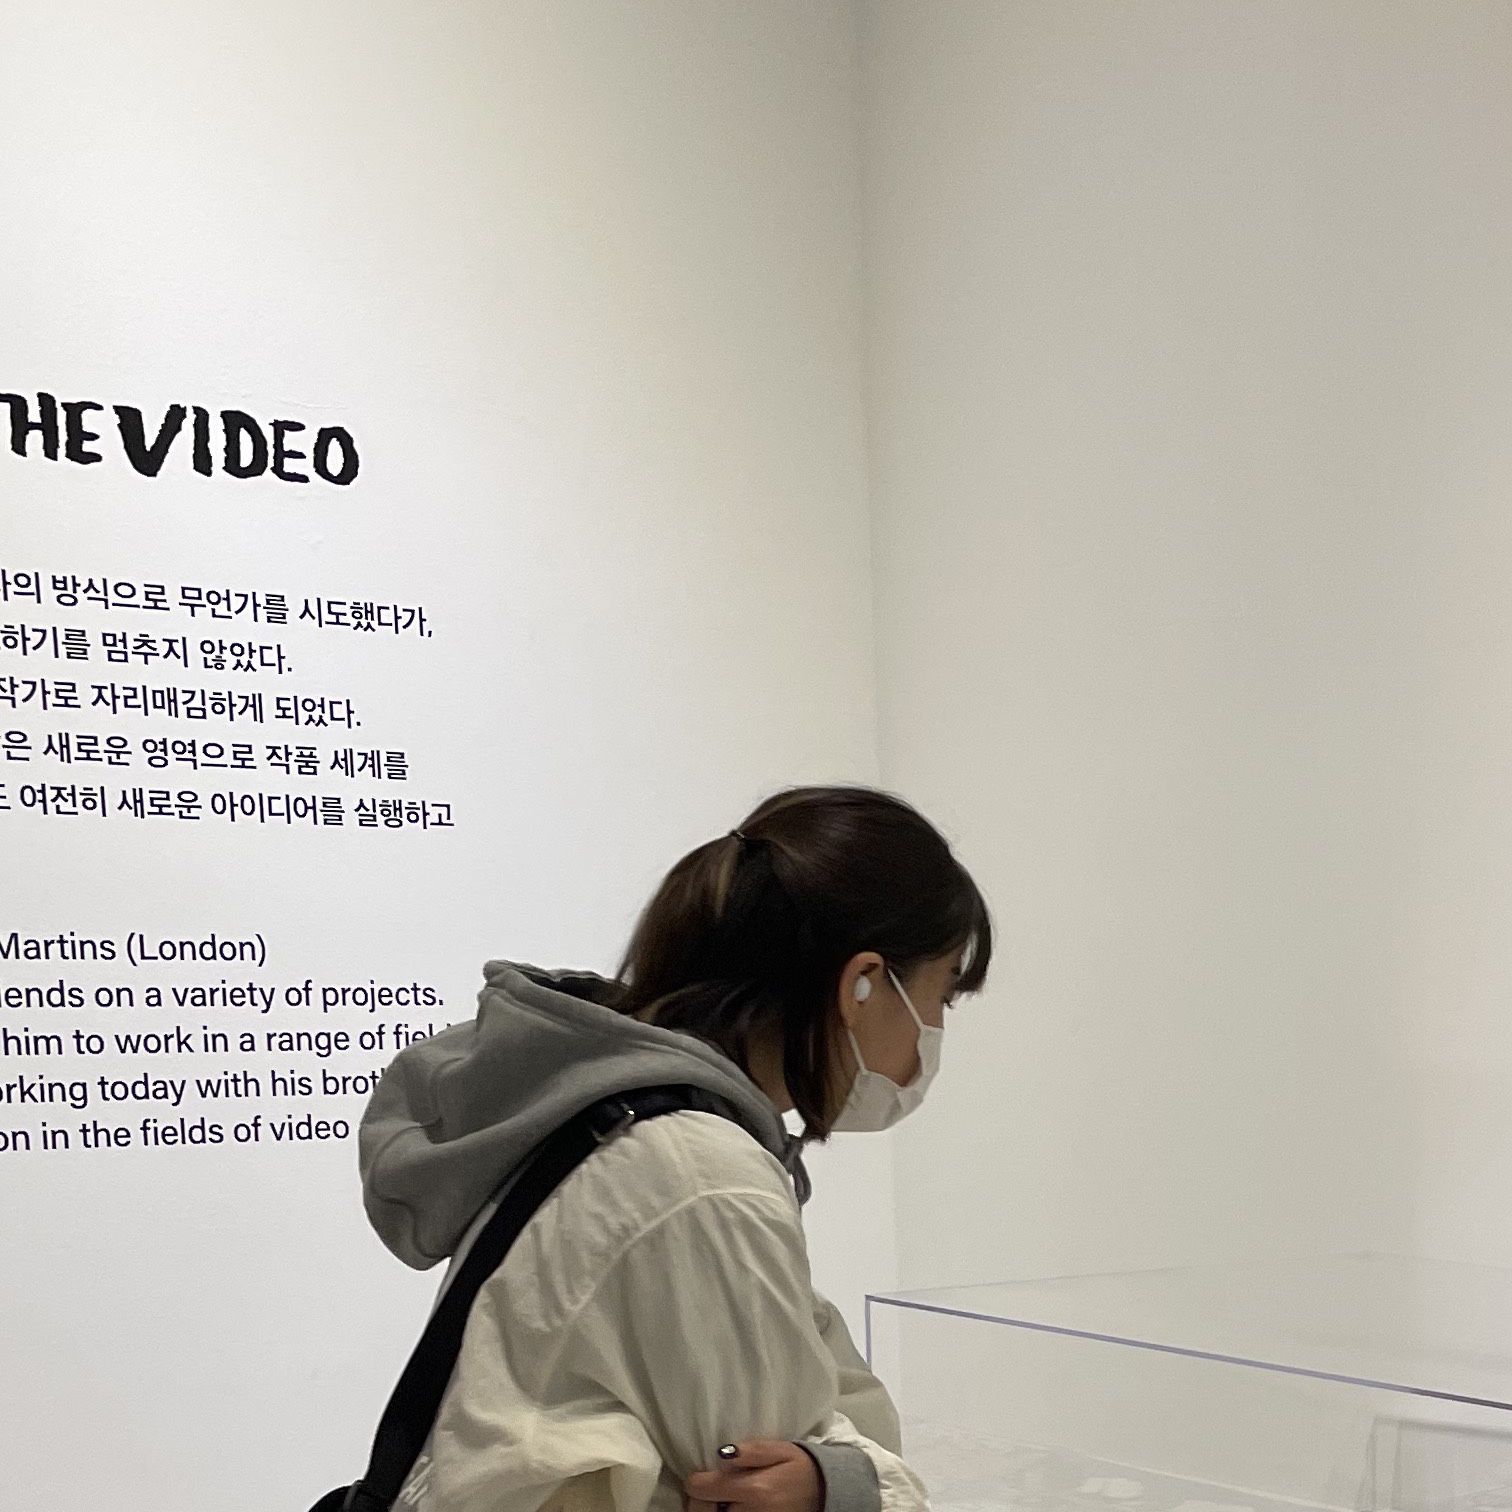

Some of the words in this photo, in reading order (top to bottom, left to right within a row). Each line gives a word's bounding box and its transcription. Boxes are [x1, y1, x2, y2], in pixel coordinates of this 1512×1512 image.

[0, 391, 105, 466] HE
[112, 403, 360, 486] VIDEO
[51, 574, 171, 612] 방식으로
[178, 586, 290, 625] 무언가를
[298, 597, 433, 638] 시도했다가,
[0, 623, 91, 661] 하기를
[101, 631, 189, 668] 멈추지
[199, 639, 293, 675] 않았다.
[0, 676, 82, 711] 작가로
[90, 682, 264, 724] 자리매김하게
[274, 695, 361, 729] 되었다.
[0, 730, 32, 762] 은
[42, 732, 133, 767] 새로운
[142, 737, 257, 771] 영역으로
[265, 744, 321, 776] 작품
[329, 747, 409, 781] 세계를
[19, 783, 107, 818] 여전히
[117, 787, 203, 820] 새로운
[210, 791, 346, 826] 아이디어를
[354, 797, 455, 830] 실행하고
[0, 931, 116, 961] Martins
[126, 932, 266, 968] (London)
[94, 987, 134, 1008] on
[145, 987, 163, 1008] a
[171, 979, 276, 1014] variety
[284, 979, 313, 1007] of
[321, 979, 444, 1014] projects.
[2, 1026, 63, 1056] him
[72, 1029, 105, 1055] to
[114, 1025, 195, 1054] work
[202, 1025, 229, 1053] in
[239, 1032, 256, 1053] a
[266, 1031, 350, 1058] range
[359, 1023, 386, 1051] of
[393, 1023, 451, 1050] fiel
[0, 1074, 88, 1110] rking
[97, 1072, 187, 1107] today
[195, 1070, 261, 1099] with
[270, 1069, 313, 1097] his
[322, 1068, 385, 1095] brot
[41, 1121, 70, 1150] in
[78, 1120, 132, 1149] the
[139, 1116, 224, 1147] fields
[233, 1114, 262, 1143] of
[269, 1113, 350, 1142] video
